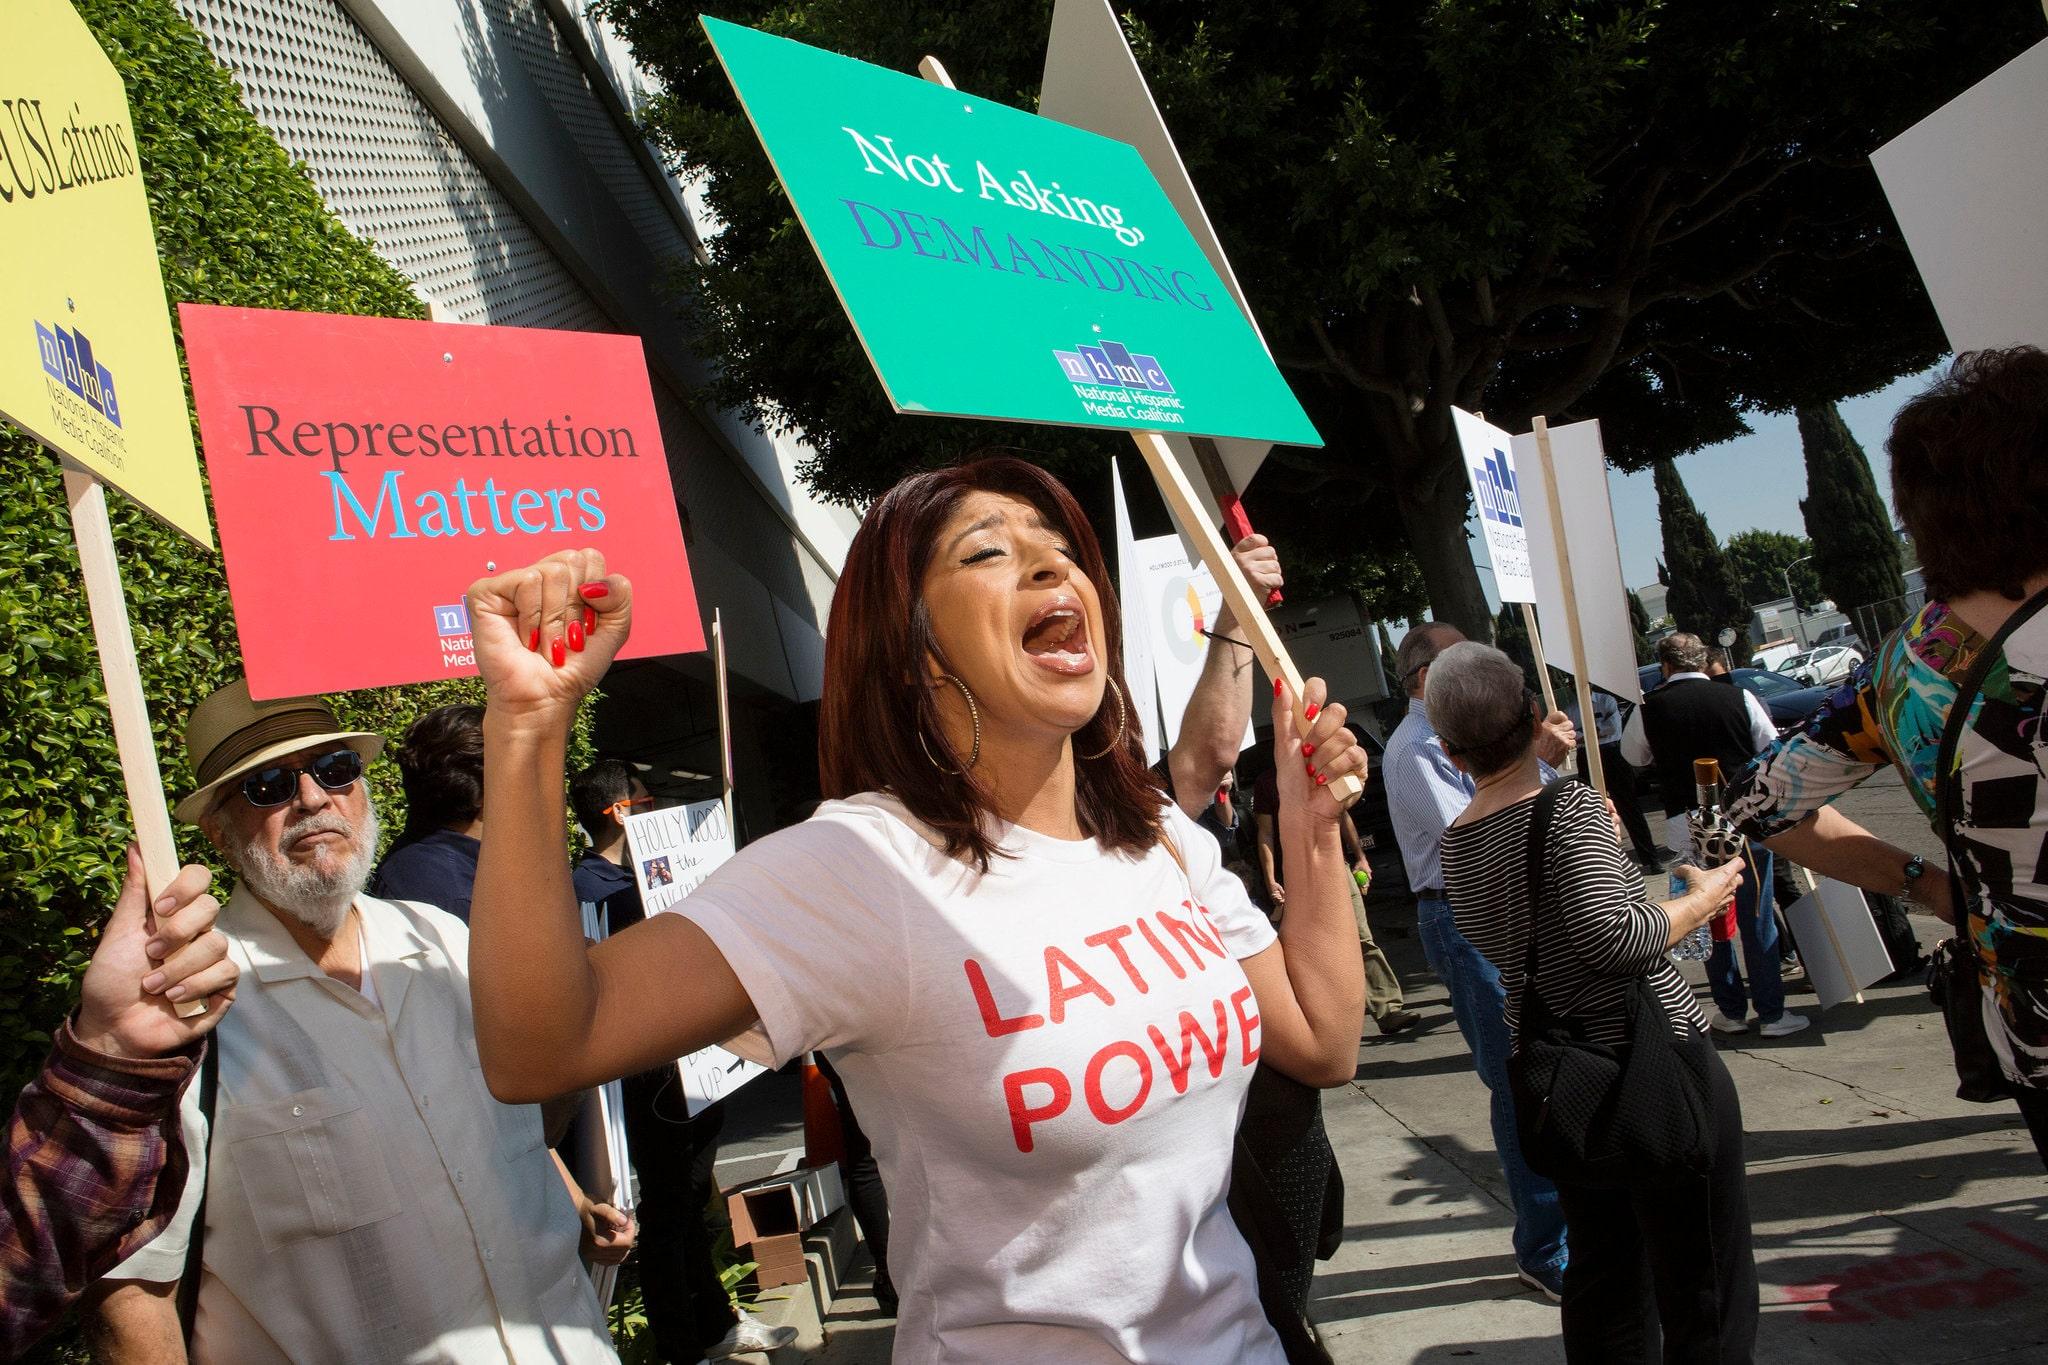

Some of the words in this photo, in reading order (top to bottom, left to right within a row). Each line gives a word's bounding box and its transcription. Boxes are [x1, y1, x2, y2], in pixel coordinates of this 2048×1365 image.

[841, 125, 964, 194] Not
[975, 159, 1145, 247] Asking,
[838, 197, 1215, 312] DEMANDING
[45, 376, 91, 426] National
[90, 411, 128, 453] Hispanic
[1072, 383, 1131, 404] National
[1129, 389, 1185, 410] Hispanic
[1081, 400, 1128, 419] Media
[1126, 405, 1185, 424] Coalition
[51, 404, 84, 445] Media
[85, 428, 126, 473] Coalition
[238, 404, 640, 474] Representation
[319, 470, 606, 541] Matters
[443, 651, 477, 668] Med
[631, 803, 728, 856] HOLLYWOOD
[674, 853, 705, 871] the
[963, 899, 1230, 1038] LATIN
[697, 1066, 723, 1102] UP
[1001, 984, 1262, 1154] POWE
